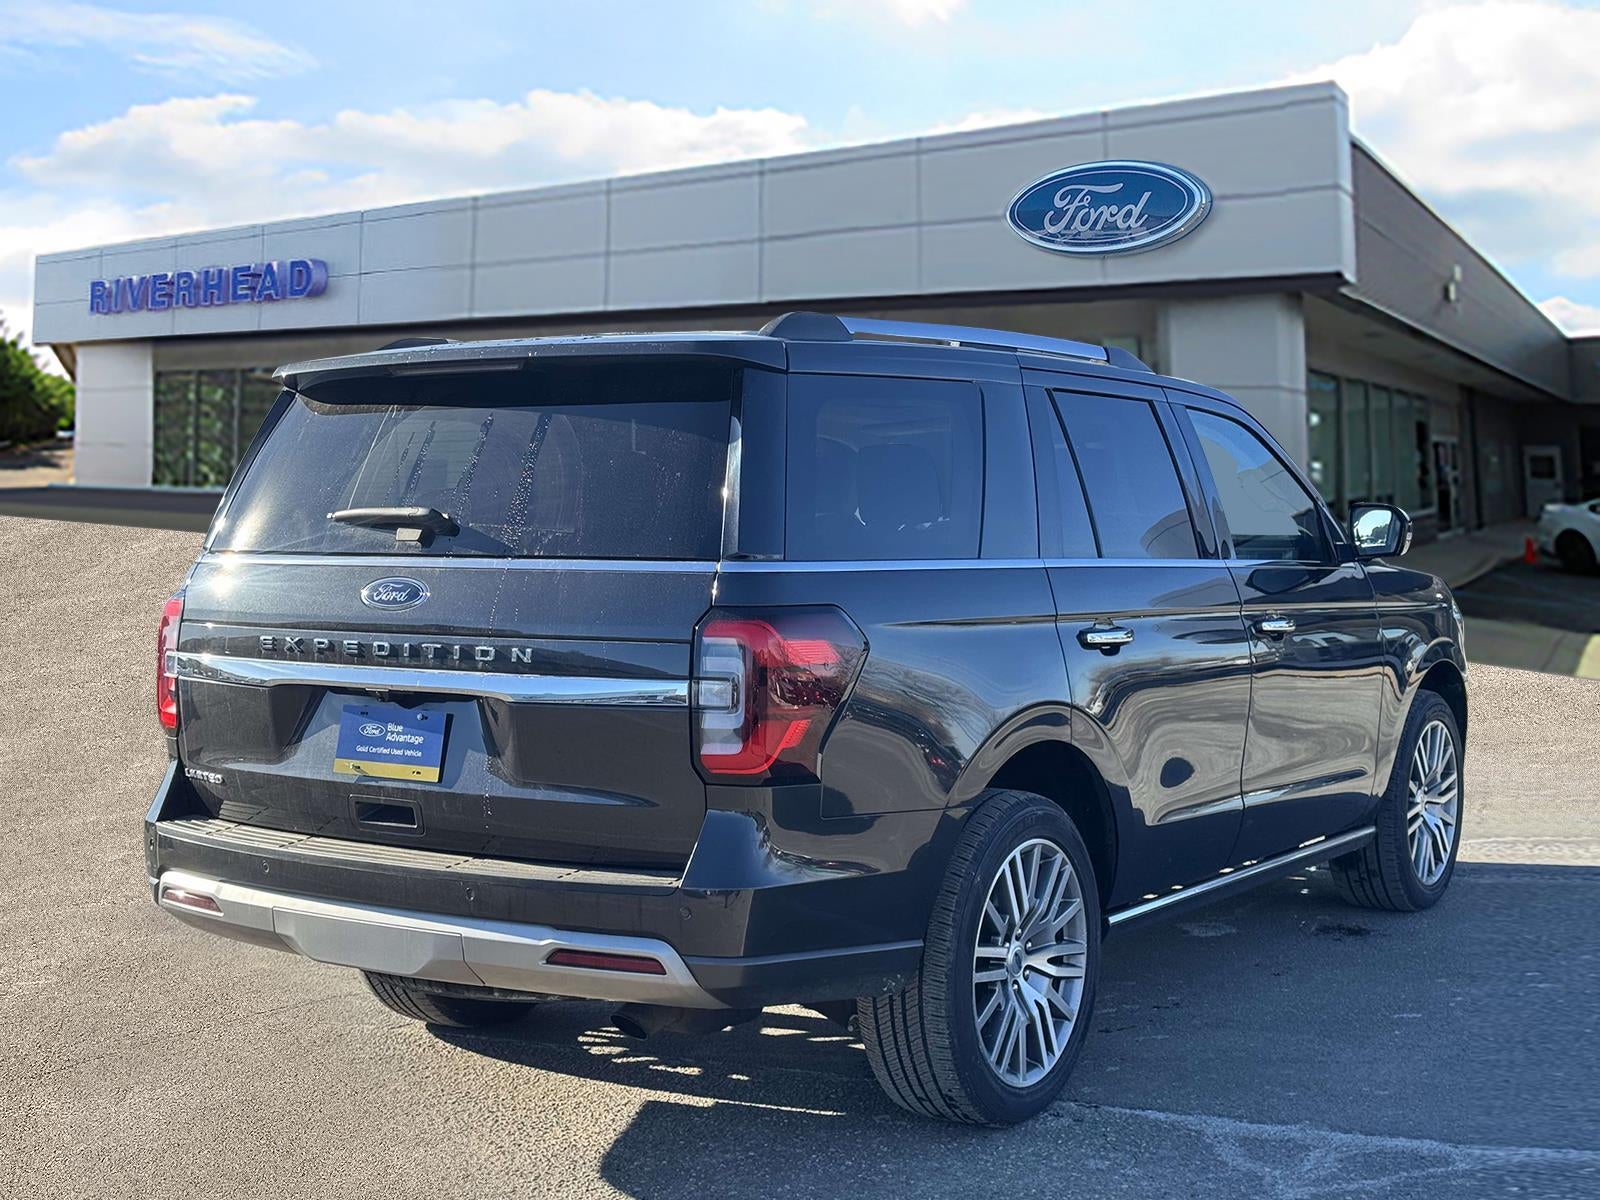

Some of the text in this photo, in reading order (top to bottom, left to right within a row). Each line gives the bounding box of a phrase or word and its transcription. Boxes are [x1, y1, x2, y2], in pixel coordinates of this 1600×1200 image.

[1044, 183, 1152, 233] Ford
[89, 259, 323, 313] RIVERHEAD
[373, 583, 411, 602] Ford
[259, 635, 532, 663] EXPEDITION
[363, 724, 382, 735] Ford
[387, 722, 404, 732] Blue
[386, 733, 424, 745] Advantage
[369, 746, 390, 755] Certified
[404, 749, 422, 757] Vehicle
